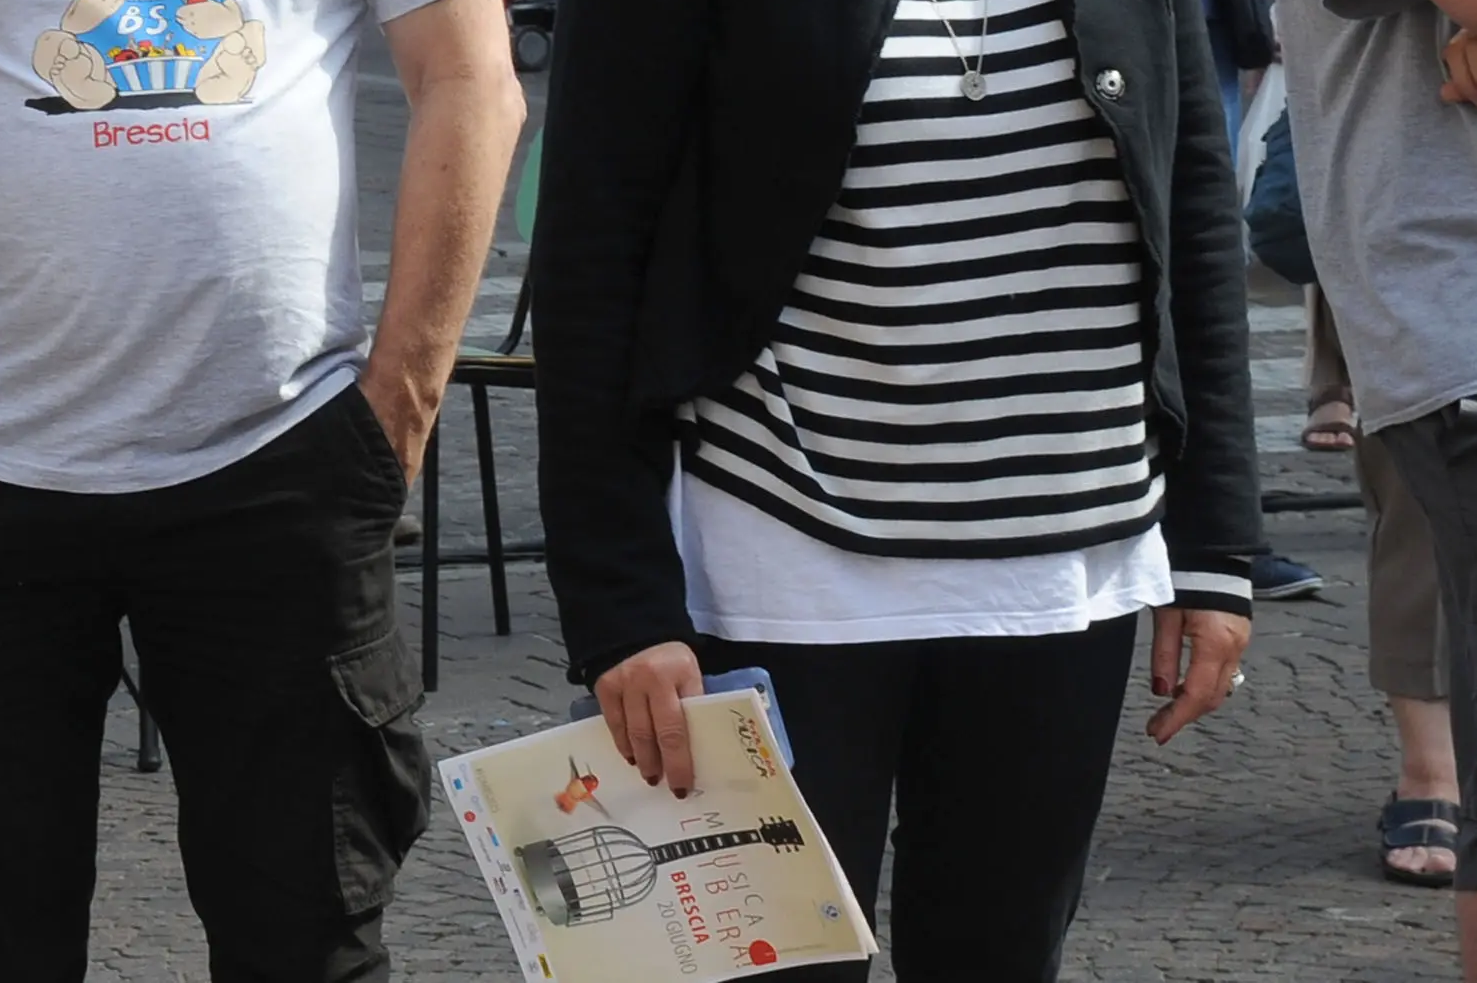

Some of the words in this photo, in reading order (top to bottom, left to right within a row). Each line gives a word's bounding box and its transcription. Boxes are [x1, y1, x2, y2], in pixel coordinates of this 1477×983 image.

[116, 4, 168, 36] BS
[93, 118, 211, 149] Brescia
[656, 900, 676, 919] 20
[670, 870, 711, 944] BRESCIA
[664, 920, 699, 976] GIUGNO
